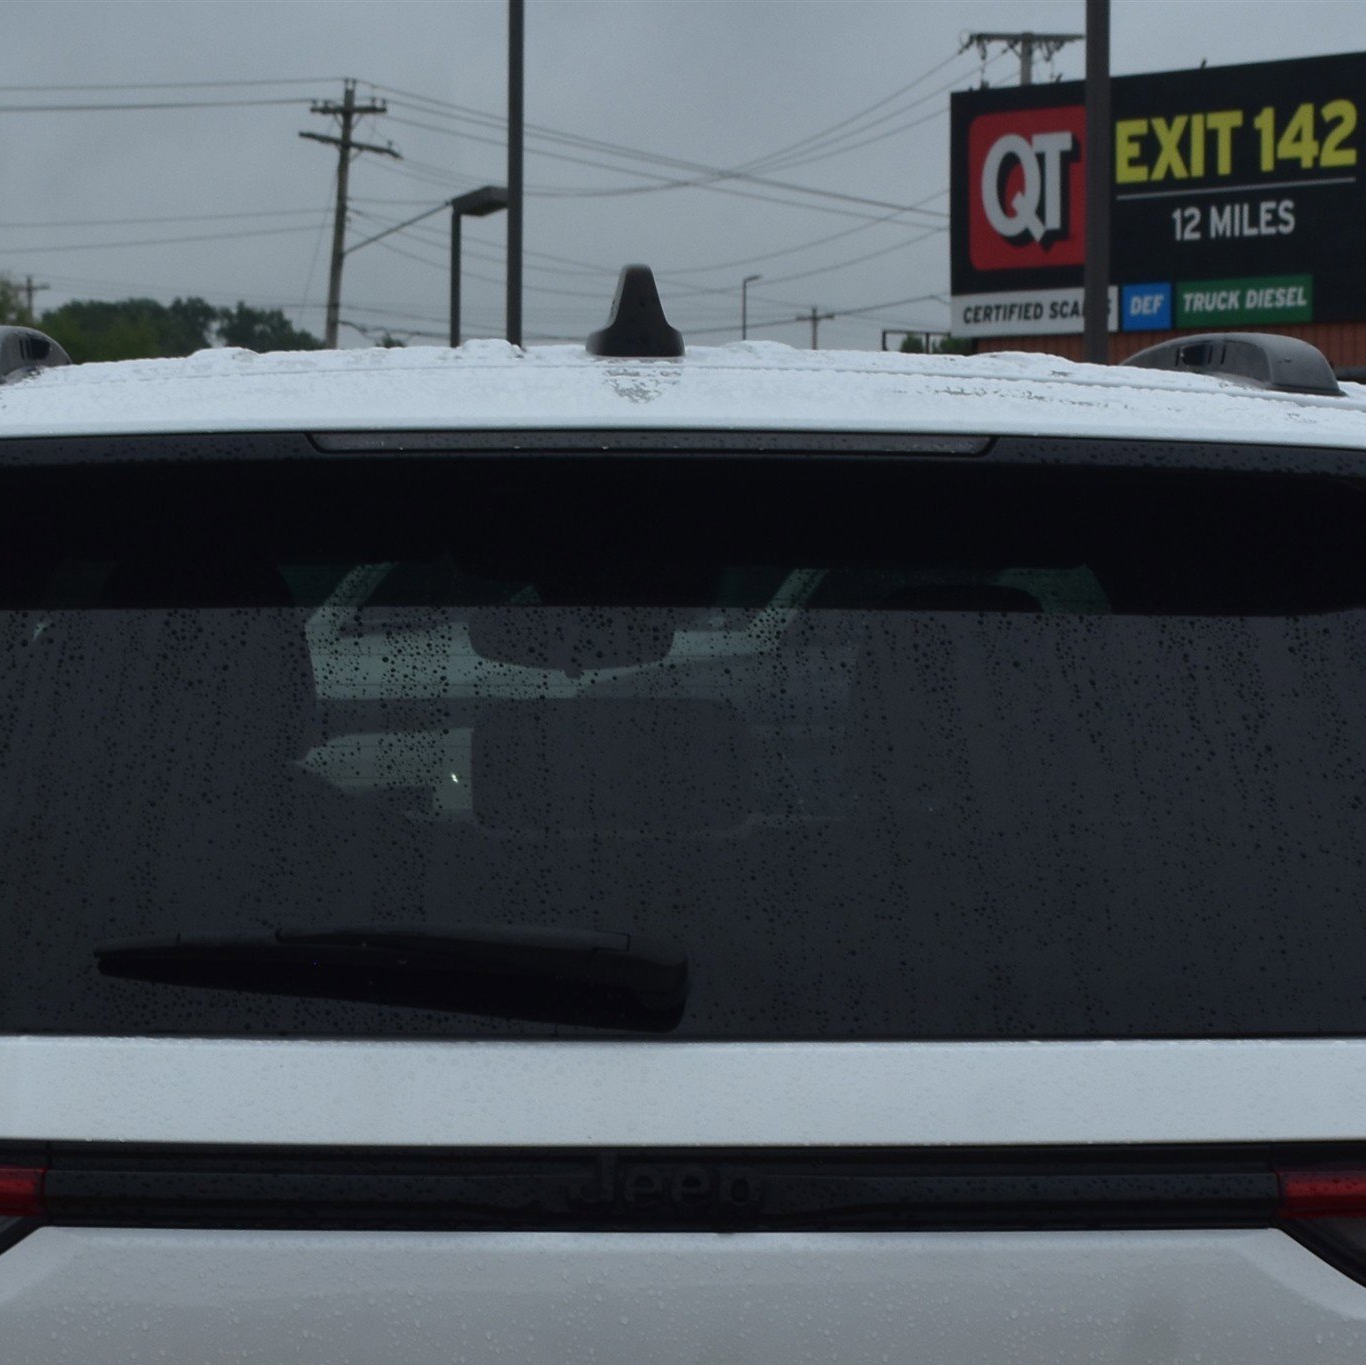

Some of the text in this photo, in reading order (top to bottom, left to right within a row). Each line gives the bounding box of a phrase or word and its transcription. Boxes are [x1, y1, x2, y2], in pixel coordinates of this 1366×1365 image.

[1115, 99, 1358, 184] EXIT 142
[981, 131, 1072, 242] QT
[1172, 200, 1295, 241] 12 MILES
[963, 302, 1043, 324] CERTIFIED
[1130, 293, 1165, 315] DEF
[1183, 286, 1308, 312] TRUCK DIESEL
